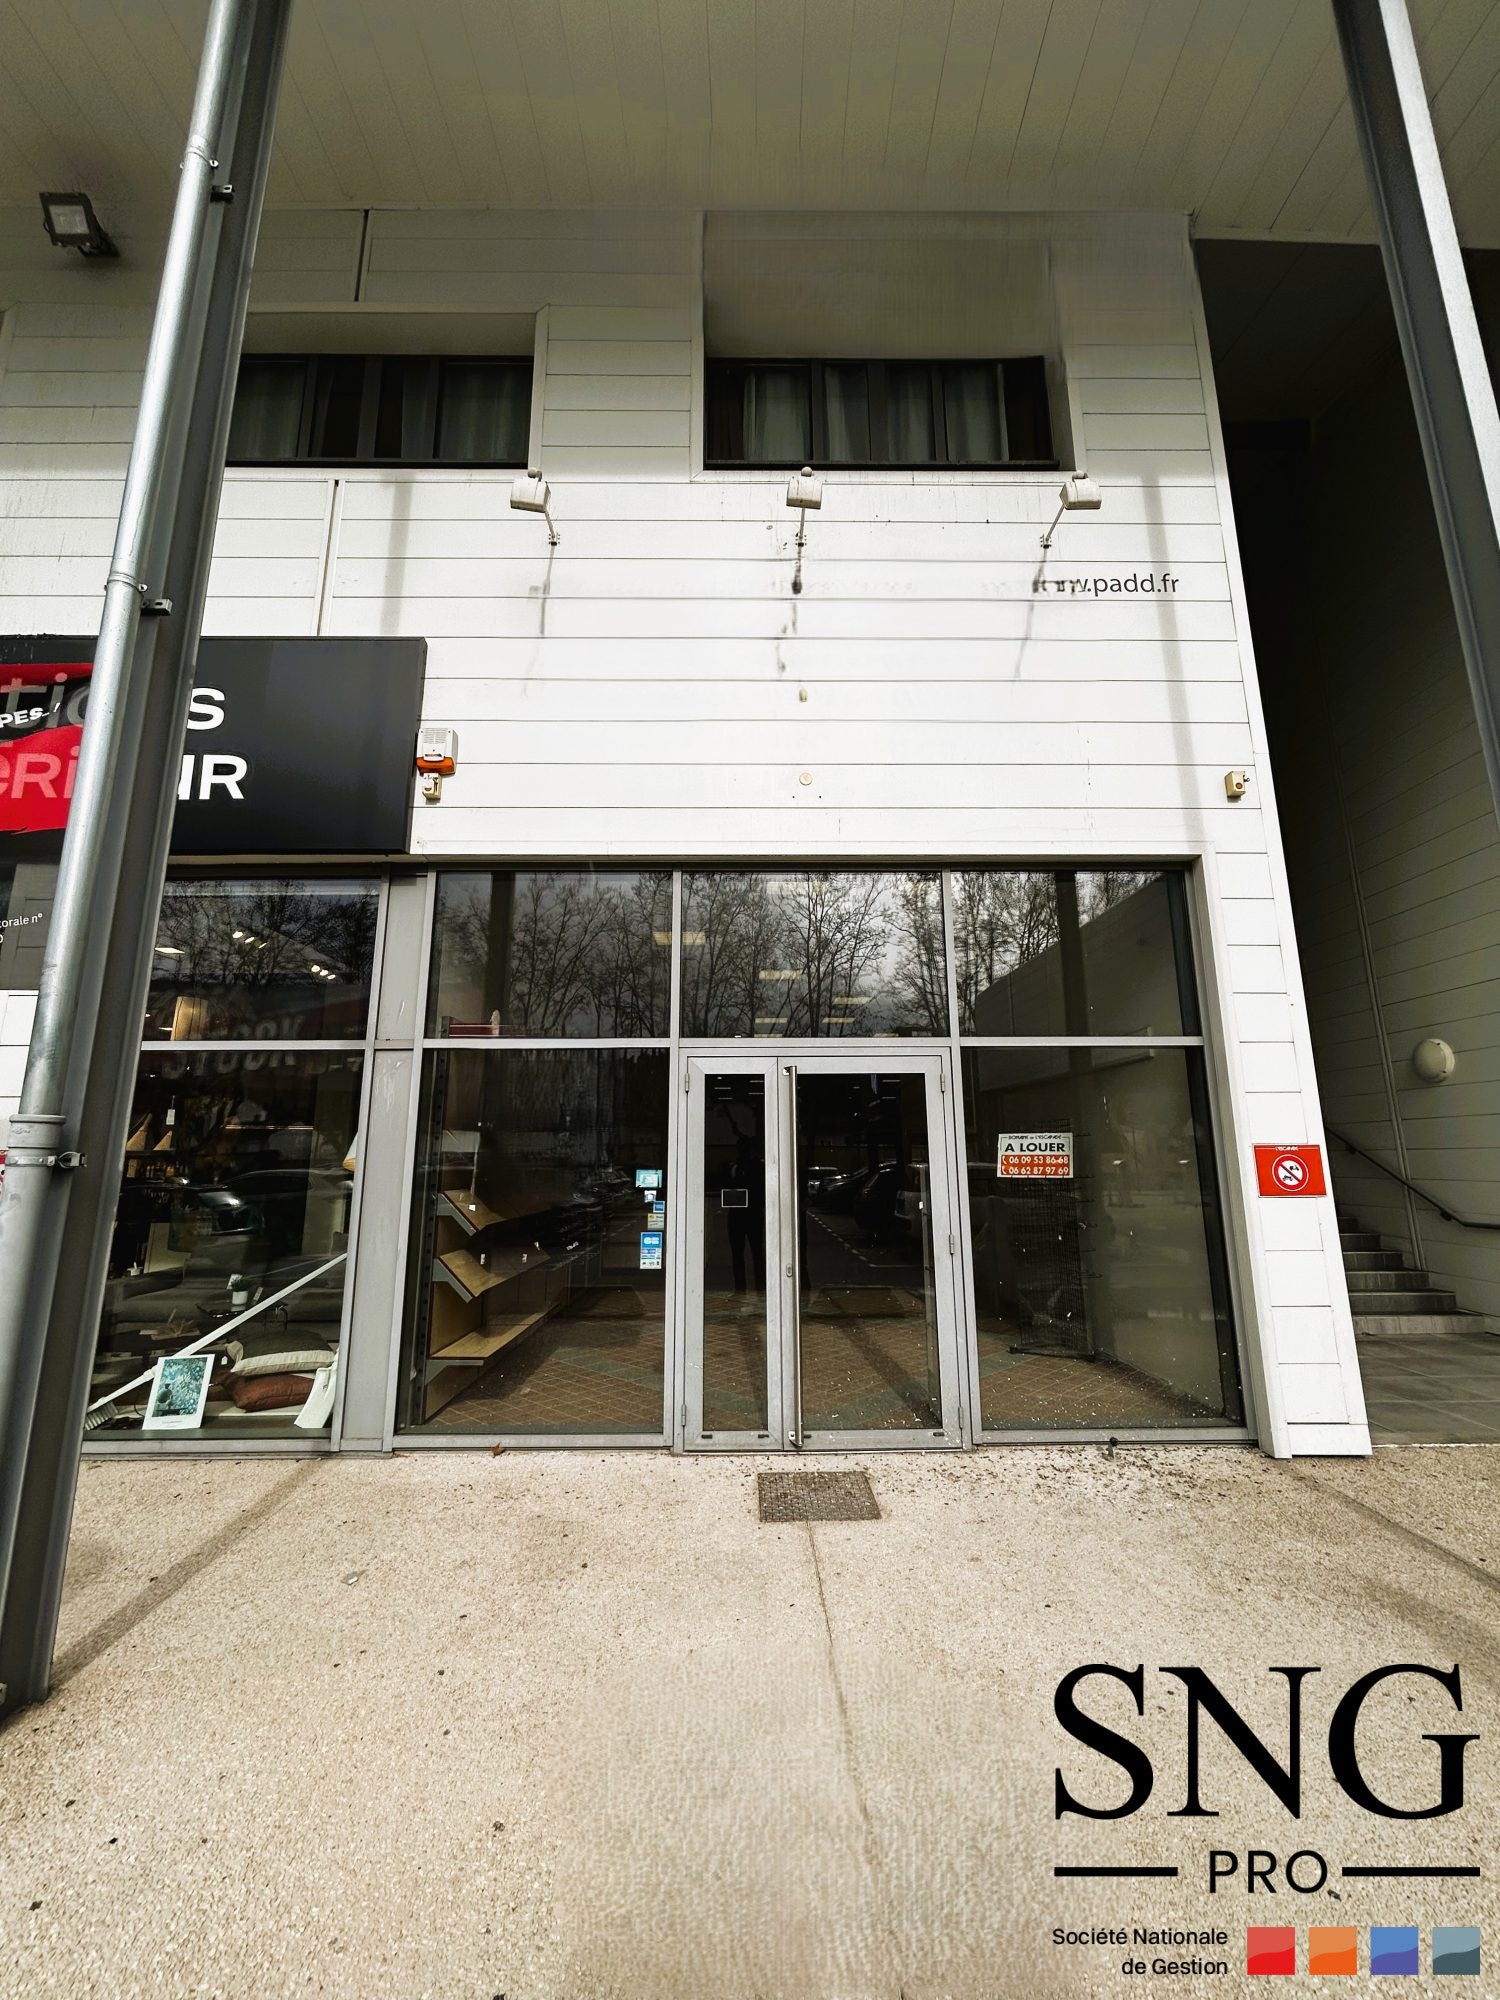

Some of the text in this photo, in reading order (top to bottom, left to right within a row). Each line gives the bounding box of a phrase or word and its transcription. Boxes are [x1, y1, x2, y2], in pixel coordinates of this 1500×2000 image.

[1005, 1142, 1065, 1152] A LOUER
[1009, 1156, 1019, 1164] 06
[1021, 1156, 1031, 1164] 09
[1033, 1156, 1043, 1164] 53
[1009, 1166, 1069, 1175] 06 62 87 97 69
